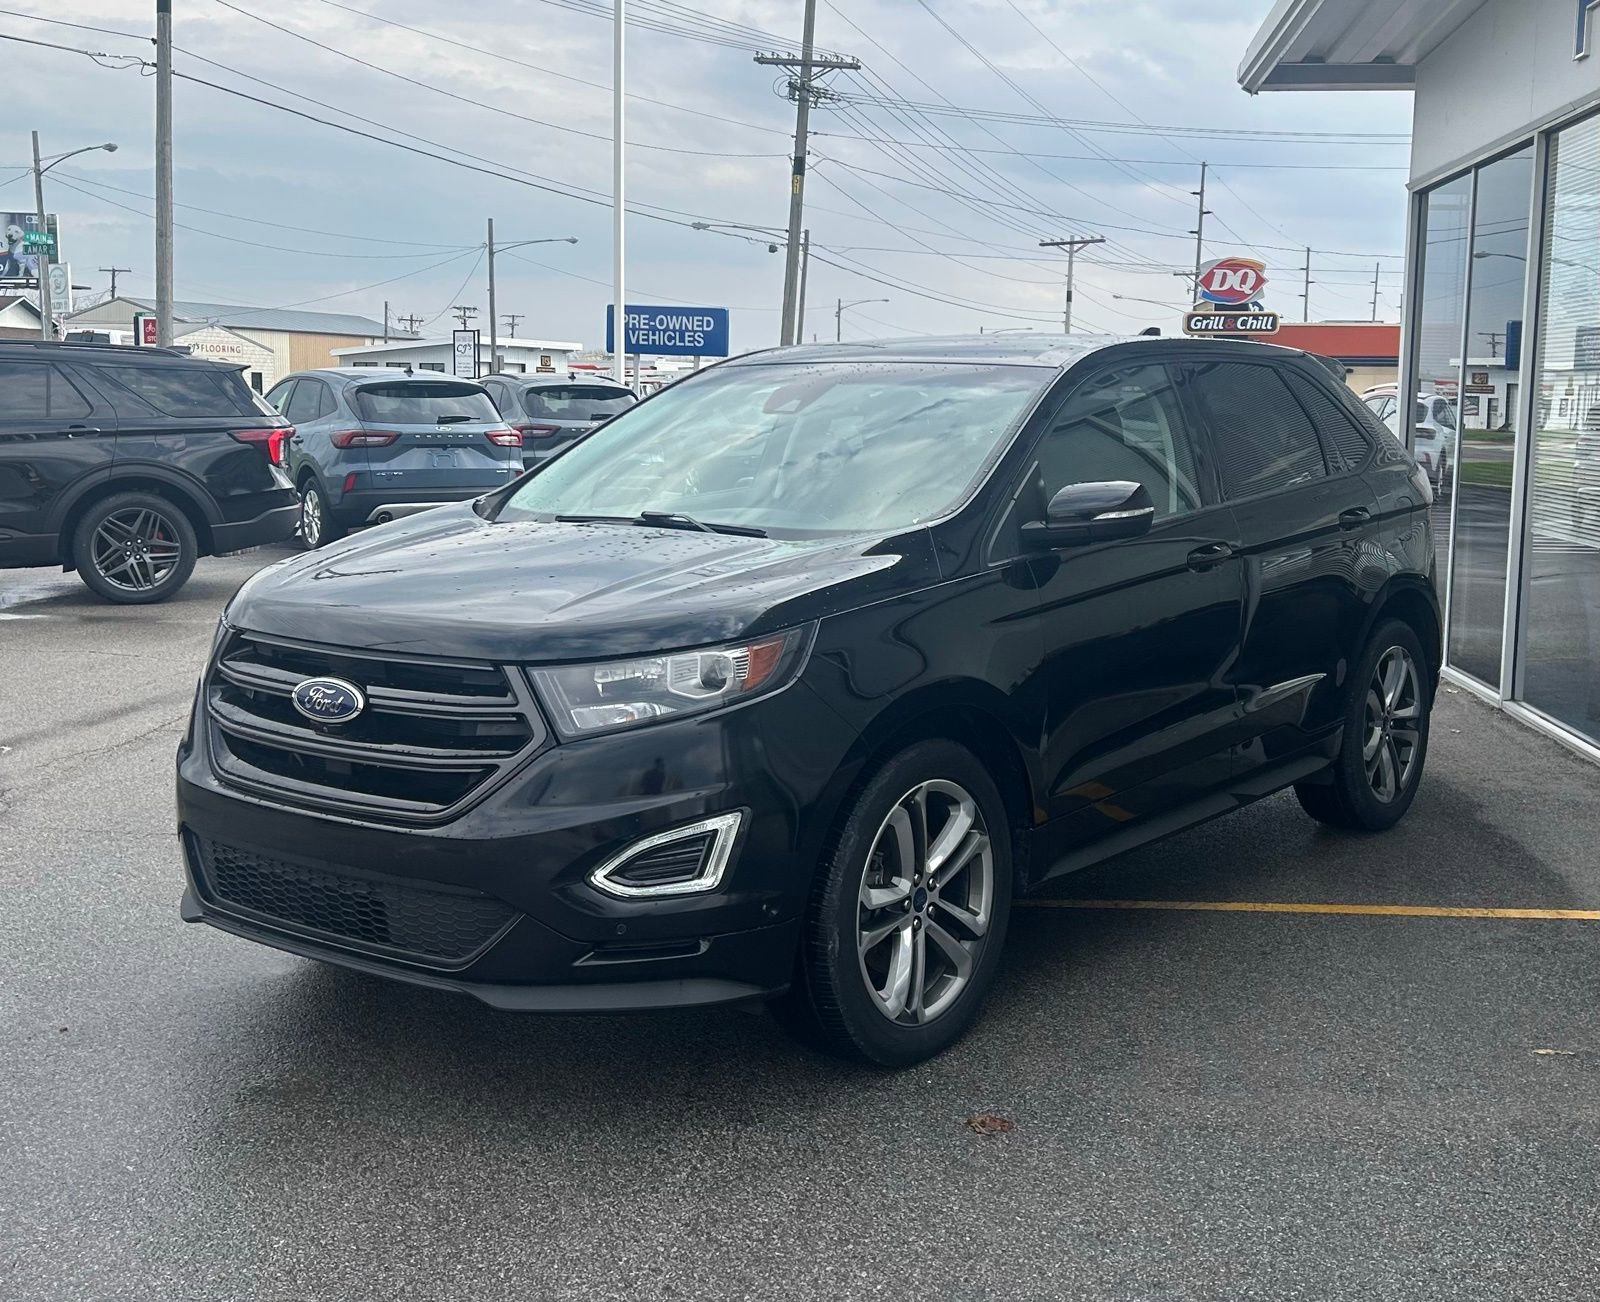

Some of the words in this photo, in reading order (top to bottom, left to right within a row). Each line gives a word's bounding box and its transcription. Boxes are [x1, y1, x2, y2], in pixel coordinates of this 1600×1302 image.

[30, 233, 47, 243] MAIN
[23, 245, 48, 255] LAMAR
[1209, 269, 1256, 294] DQ
[1190, 316, 1225, 330] Grill
[1225, 318, 1236, 330] &
[1236, 316, 1274, 330] Chill
[629, 330, 705, 347] VEHICLES
[200, 343, 241, 354] FLOORING
[456, 343, 473, 355] CJ's
[304, 686, 345, 713] Ford
